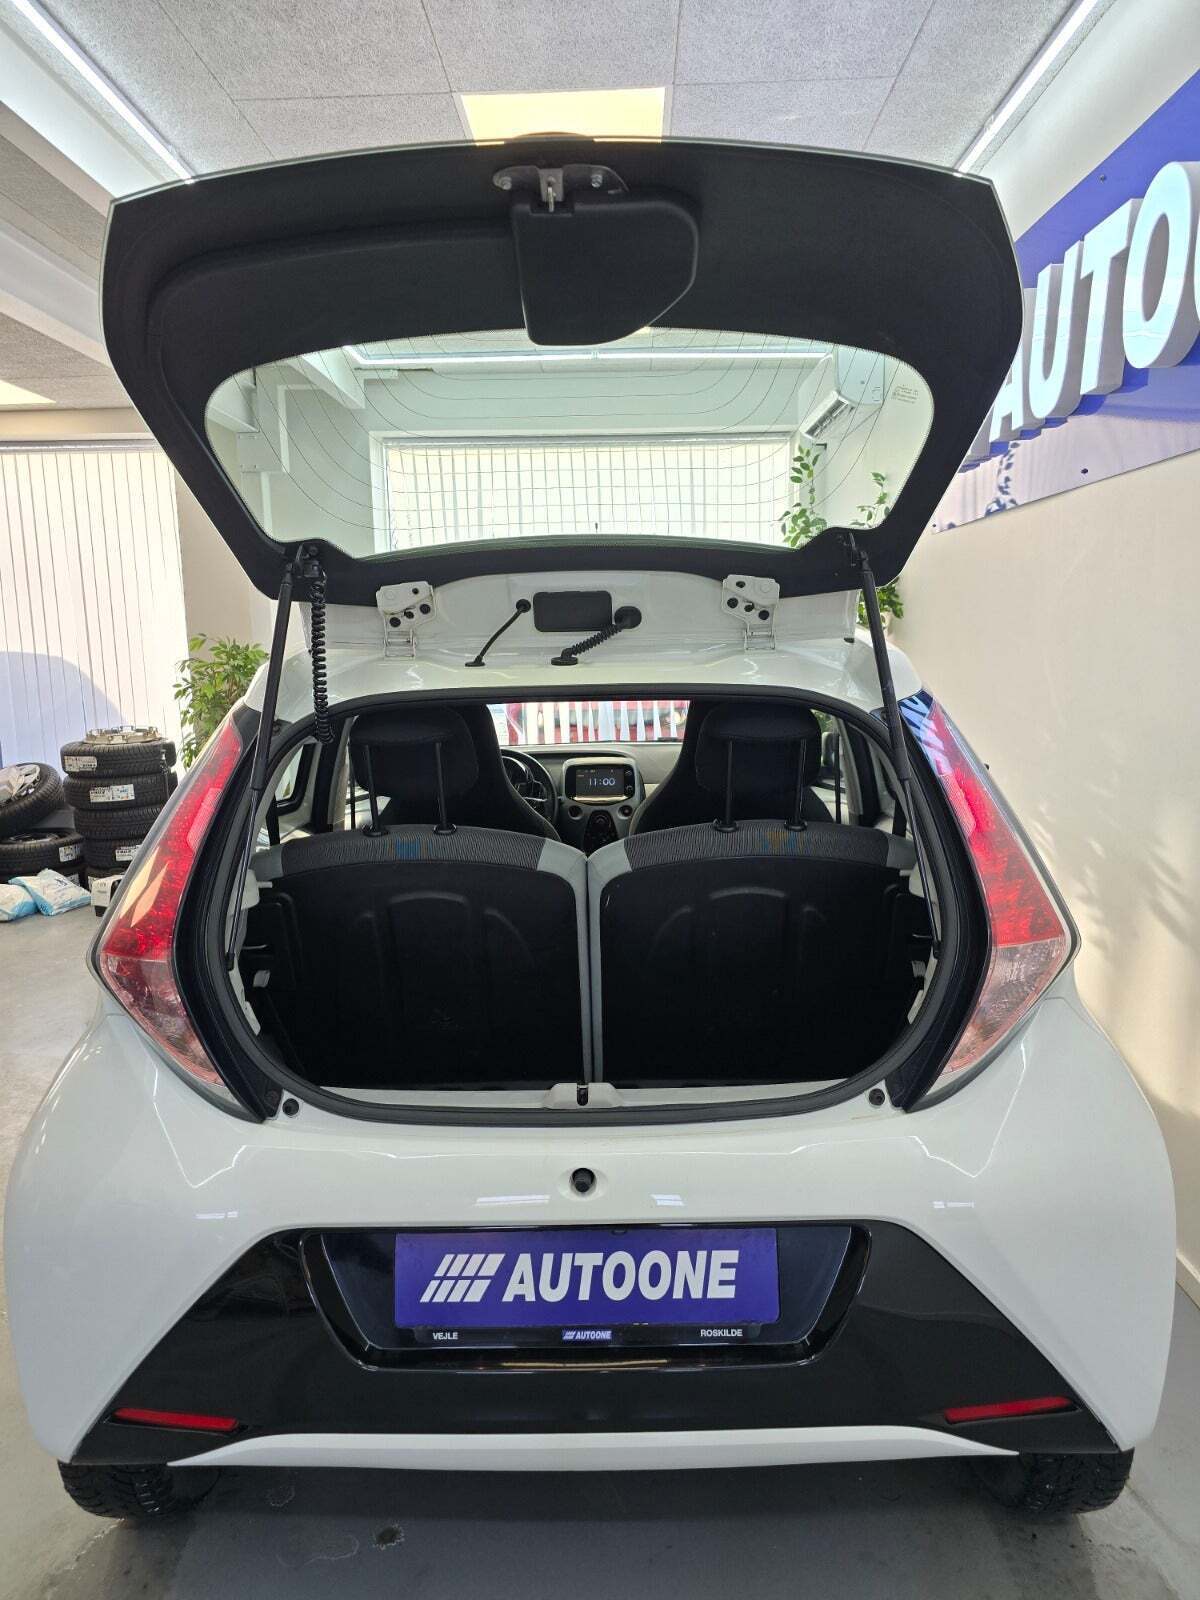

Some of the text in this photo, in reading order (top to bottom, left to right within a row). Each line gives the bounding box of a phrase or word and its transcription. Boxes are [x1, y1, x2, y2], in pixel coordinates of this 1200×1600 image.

[988, 161, 1200, 443] AUTO
[589, 777, 616, 787] 11:00
[501, 1249, 740, 1303] AUTOONE
[432, 1331, 459, 1341] VEJLE
[574, 1330, 613, 1340] AUTOONE
[700, 1328, 744, 1337] ROSKILDE
